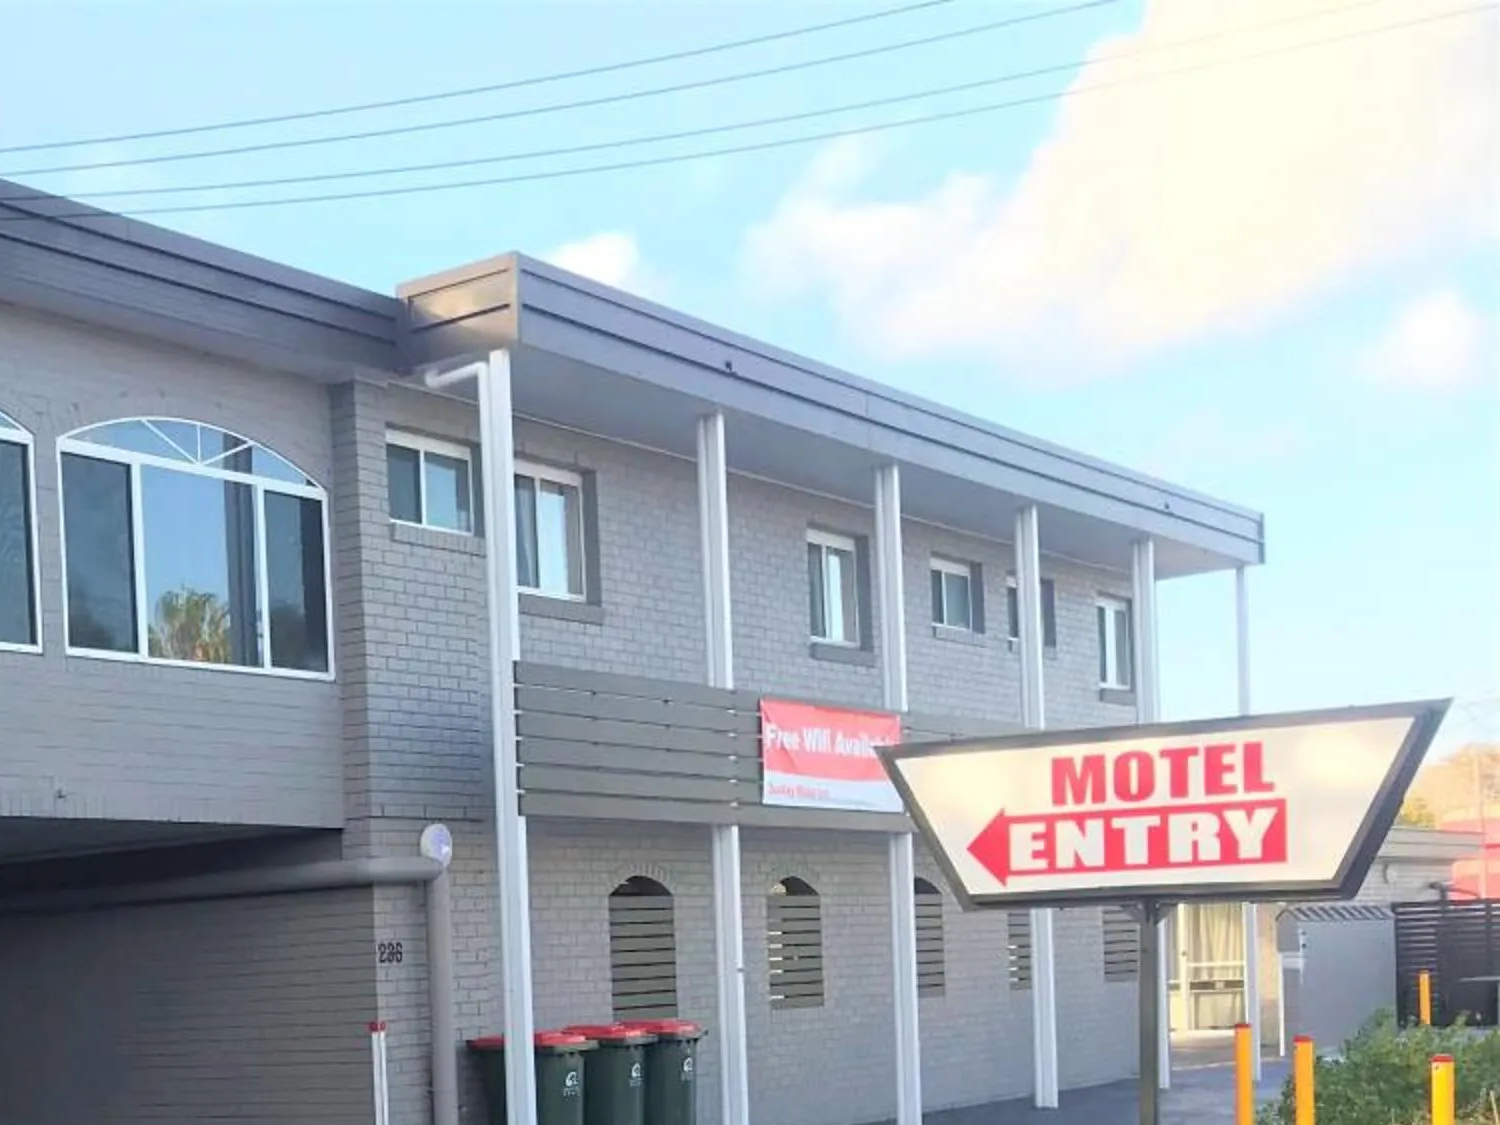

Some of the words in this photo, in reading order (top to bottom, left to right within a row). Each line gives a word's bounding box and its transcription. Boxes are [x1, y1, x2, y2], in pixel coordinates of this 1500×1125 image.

[764, 723, 800, 751] Free
[1051, 741, 1275, 806] MOTEL
[1008, 806, 1278, 872] ENTRY
